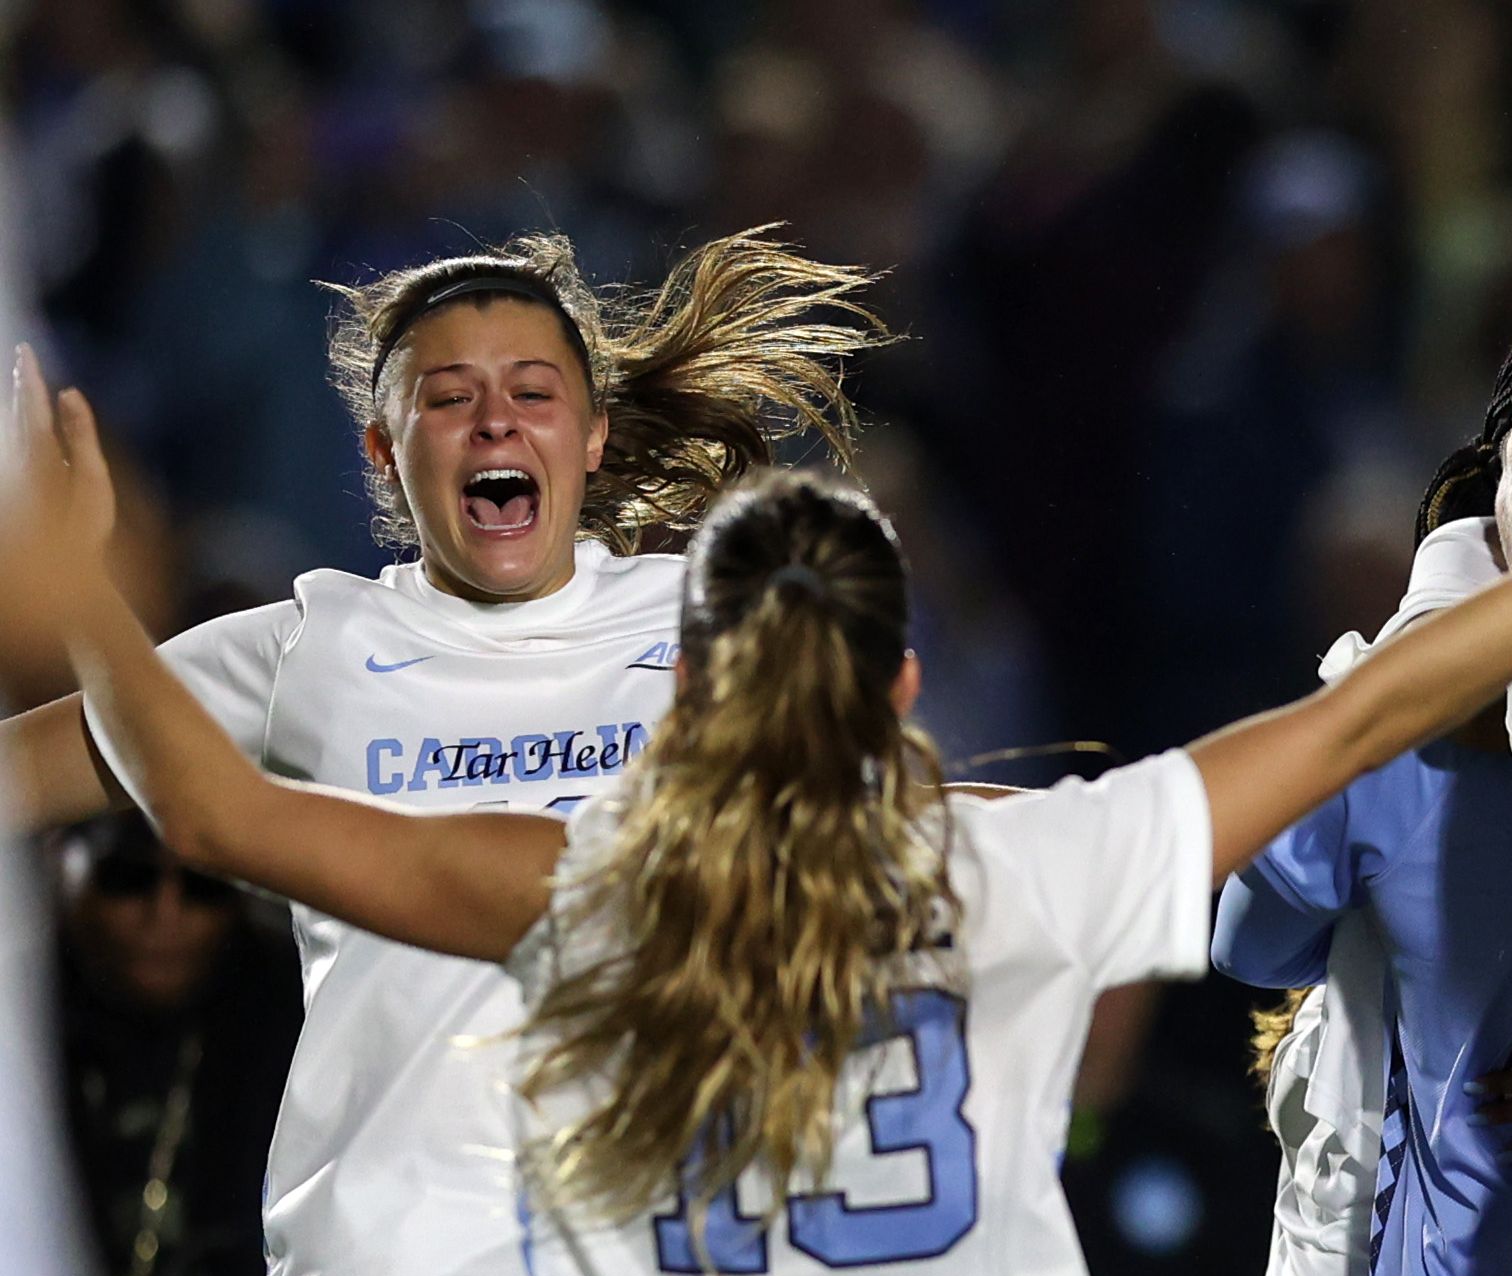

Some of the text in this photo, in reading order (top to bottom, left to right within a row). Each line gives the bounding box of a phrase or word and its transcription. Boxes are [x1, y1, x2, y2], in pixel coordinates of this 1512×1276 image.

[432, 723, 643, 782] Tar Heel
[652, 985, 979, 1276] 13
